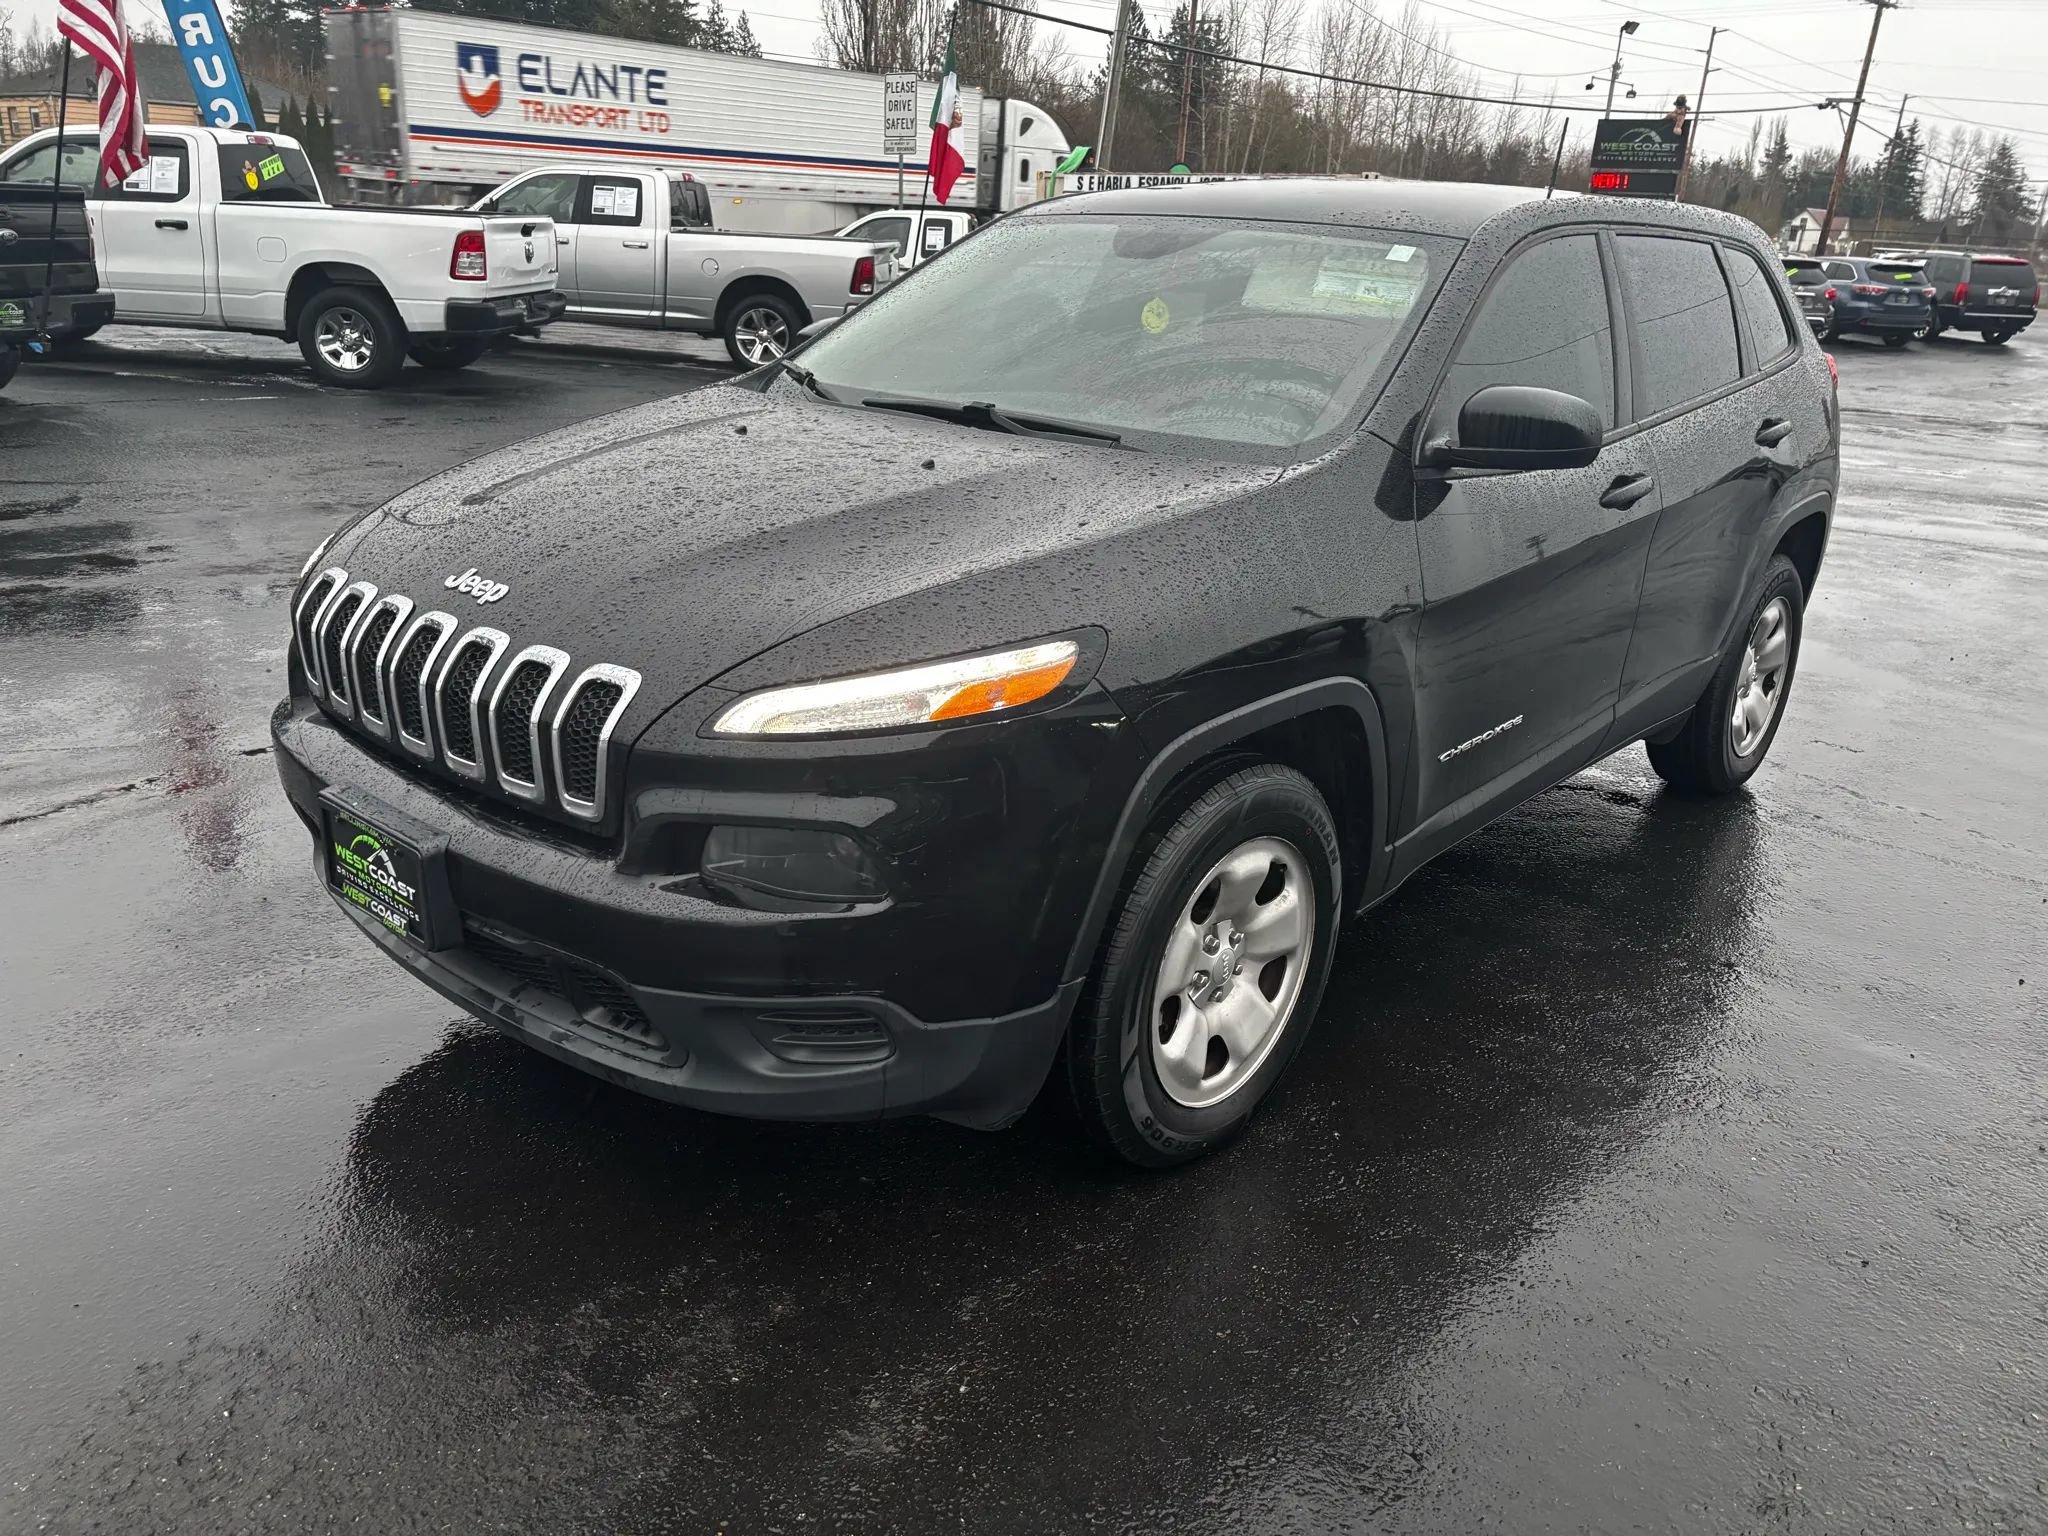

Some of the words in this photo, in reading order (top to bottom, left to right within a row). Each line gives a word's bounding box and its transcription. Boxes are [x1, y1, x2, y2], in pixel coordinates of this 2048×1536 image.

[518, 53, 668, 105] ELANTE
[886, 81, 915, 93] PLEASE
[519, 99, 630, 129] TRANSPORT
[638, 110, 671, 133] LTD
[888, 99, 912, 112] DRIVE
[886, 118, 915, 130] SAFELY
[444, 568, 509, 605] Jeep
[1439, 714, 1523, 762] CHEROKEE
[336, 865, 368, 889] DRIVING
[369, 885, 420, 921] EXCELLENCE
[358, 871, 393, 897] MOTORS
[383, 917, 408, 937] MOTORS
